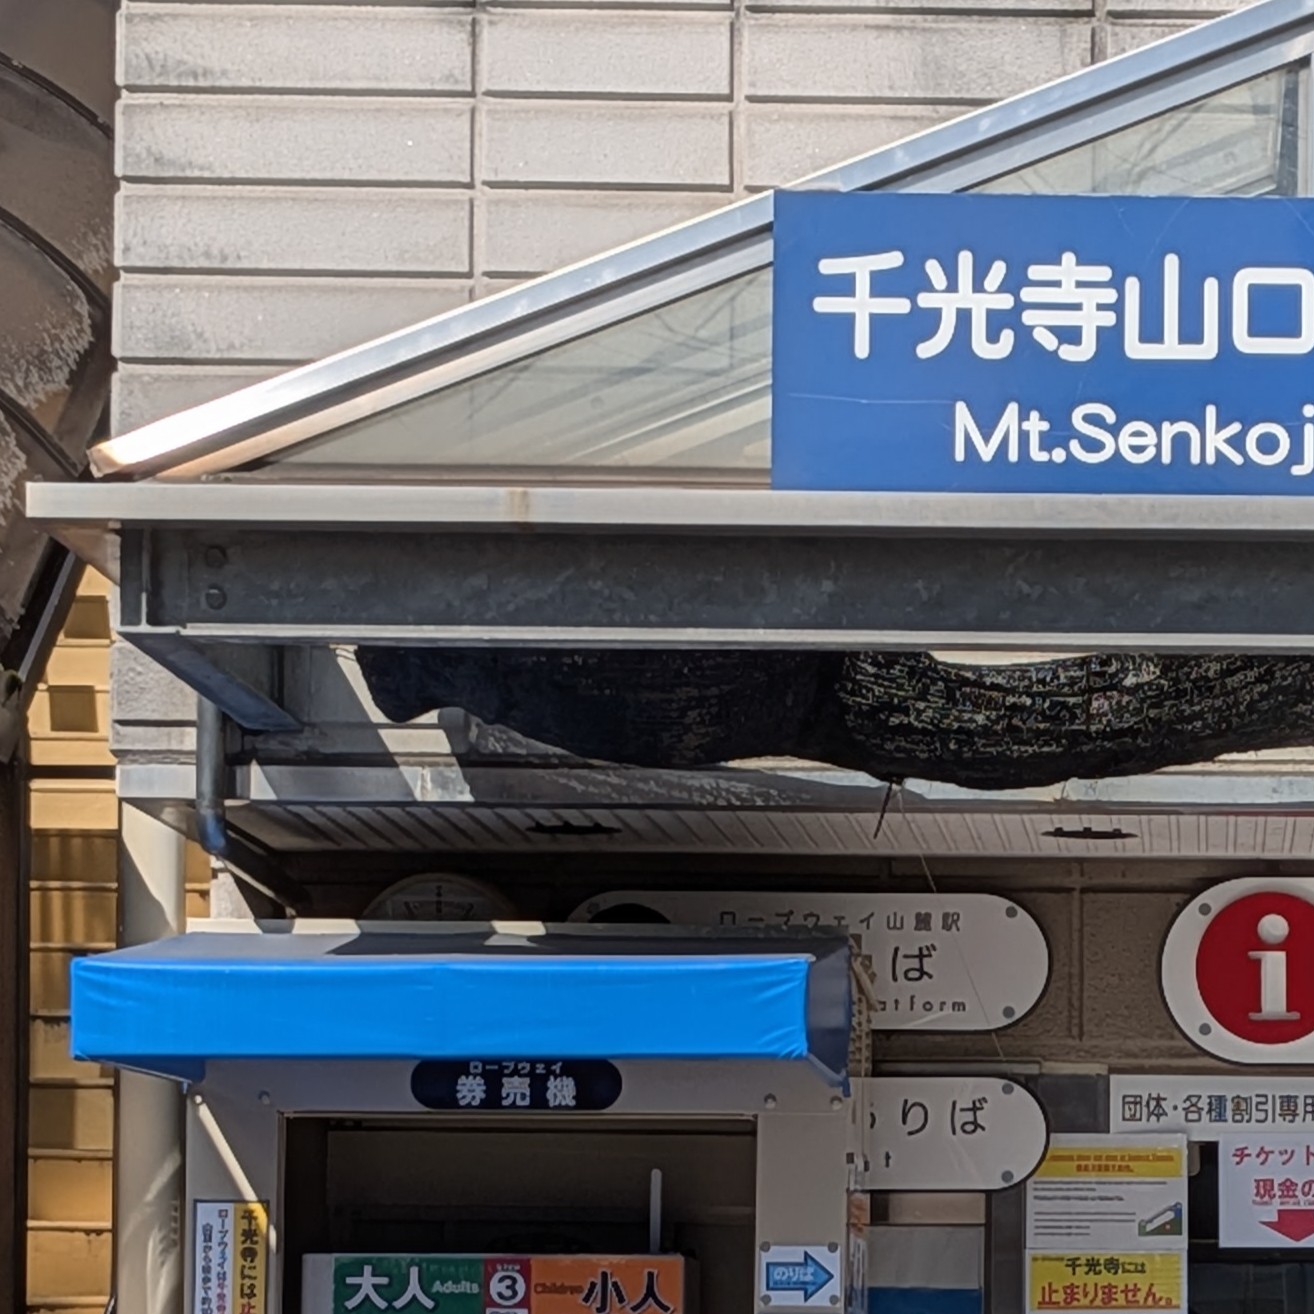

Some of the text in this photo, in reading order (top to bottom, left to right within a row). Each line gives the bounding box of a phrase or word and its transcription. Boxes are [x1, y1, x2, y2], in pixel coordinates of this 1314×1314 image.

[773, 1267, 816, 1282] のりば
[1064, 1256, 1147, 1276] 千光寺には
[343, 1265, 436, 1311] 大人
[431, 1279, 480, 1294] Adults
[496, 1274, 519, 1302] 3
[1037, 1282, 1174, 1306] 止まりません。
